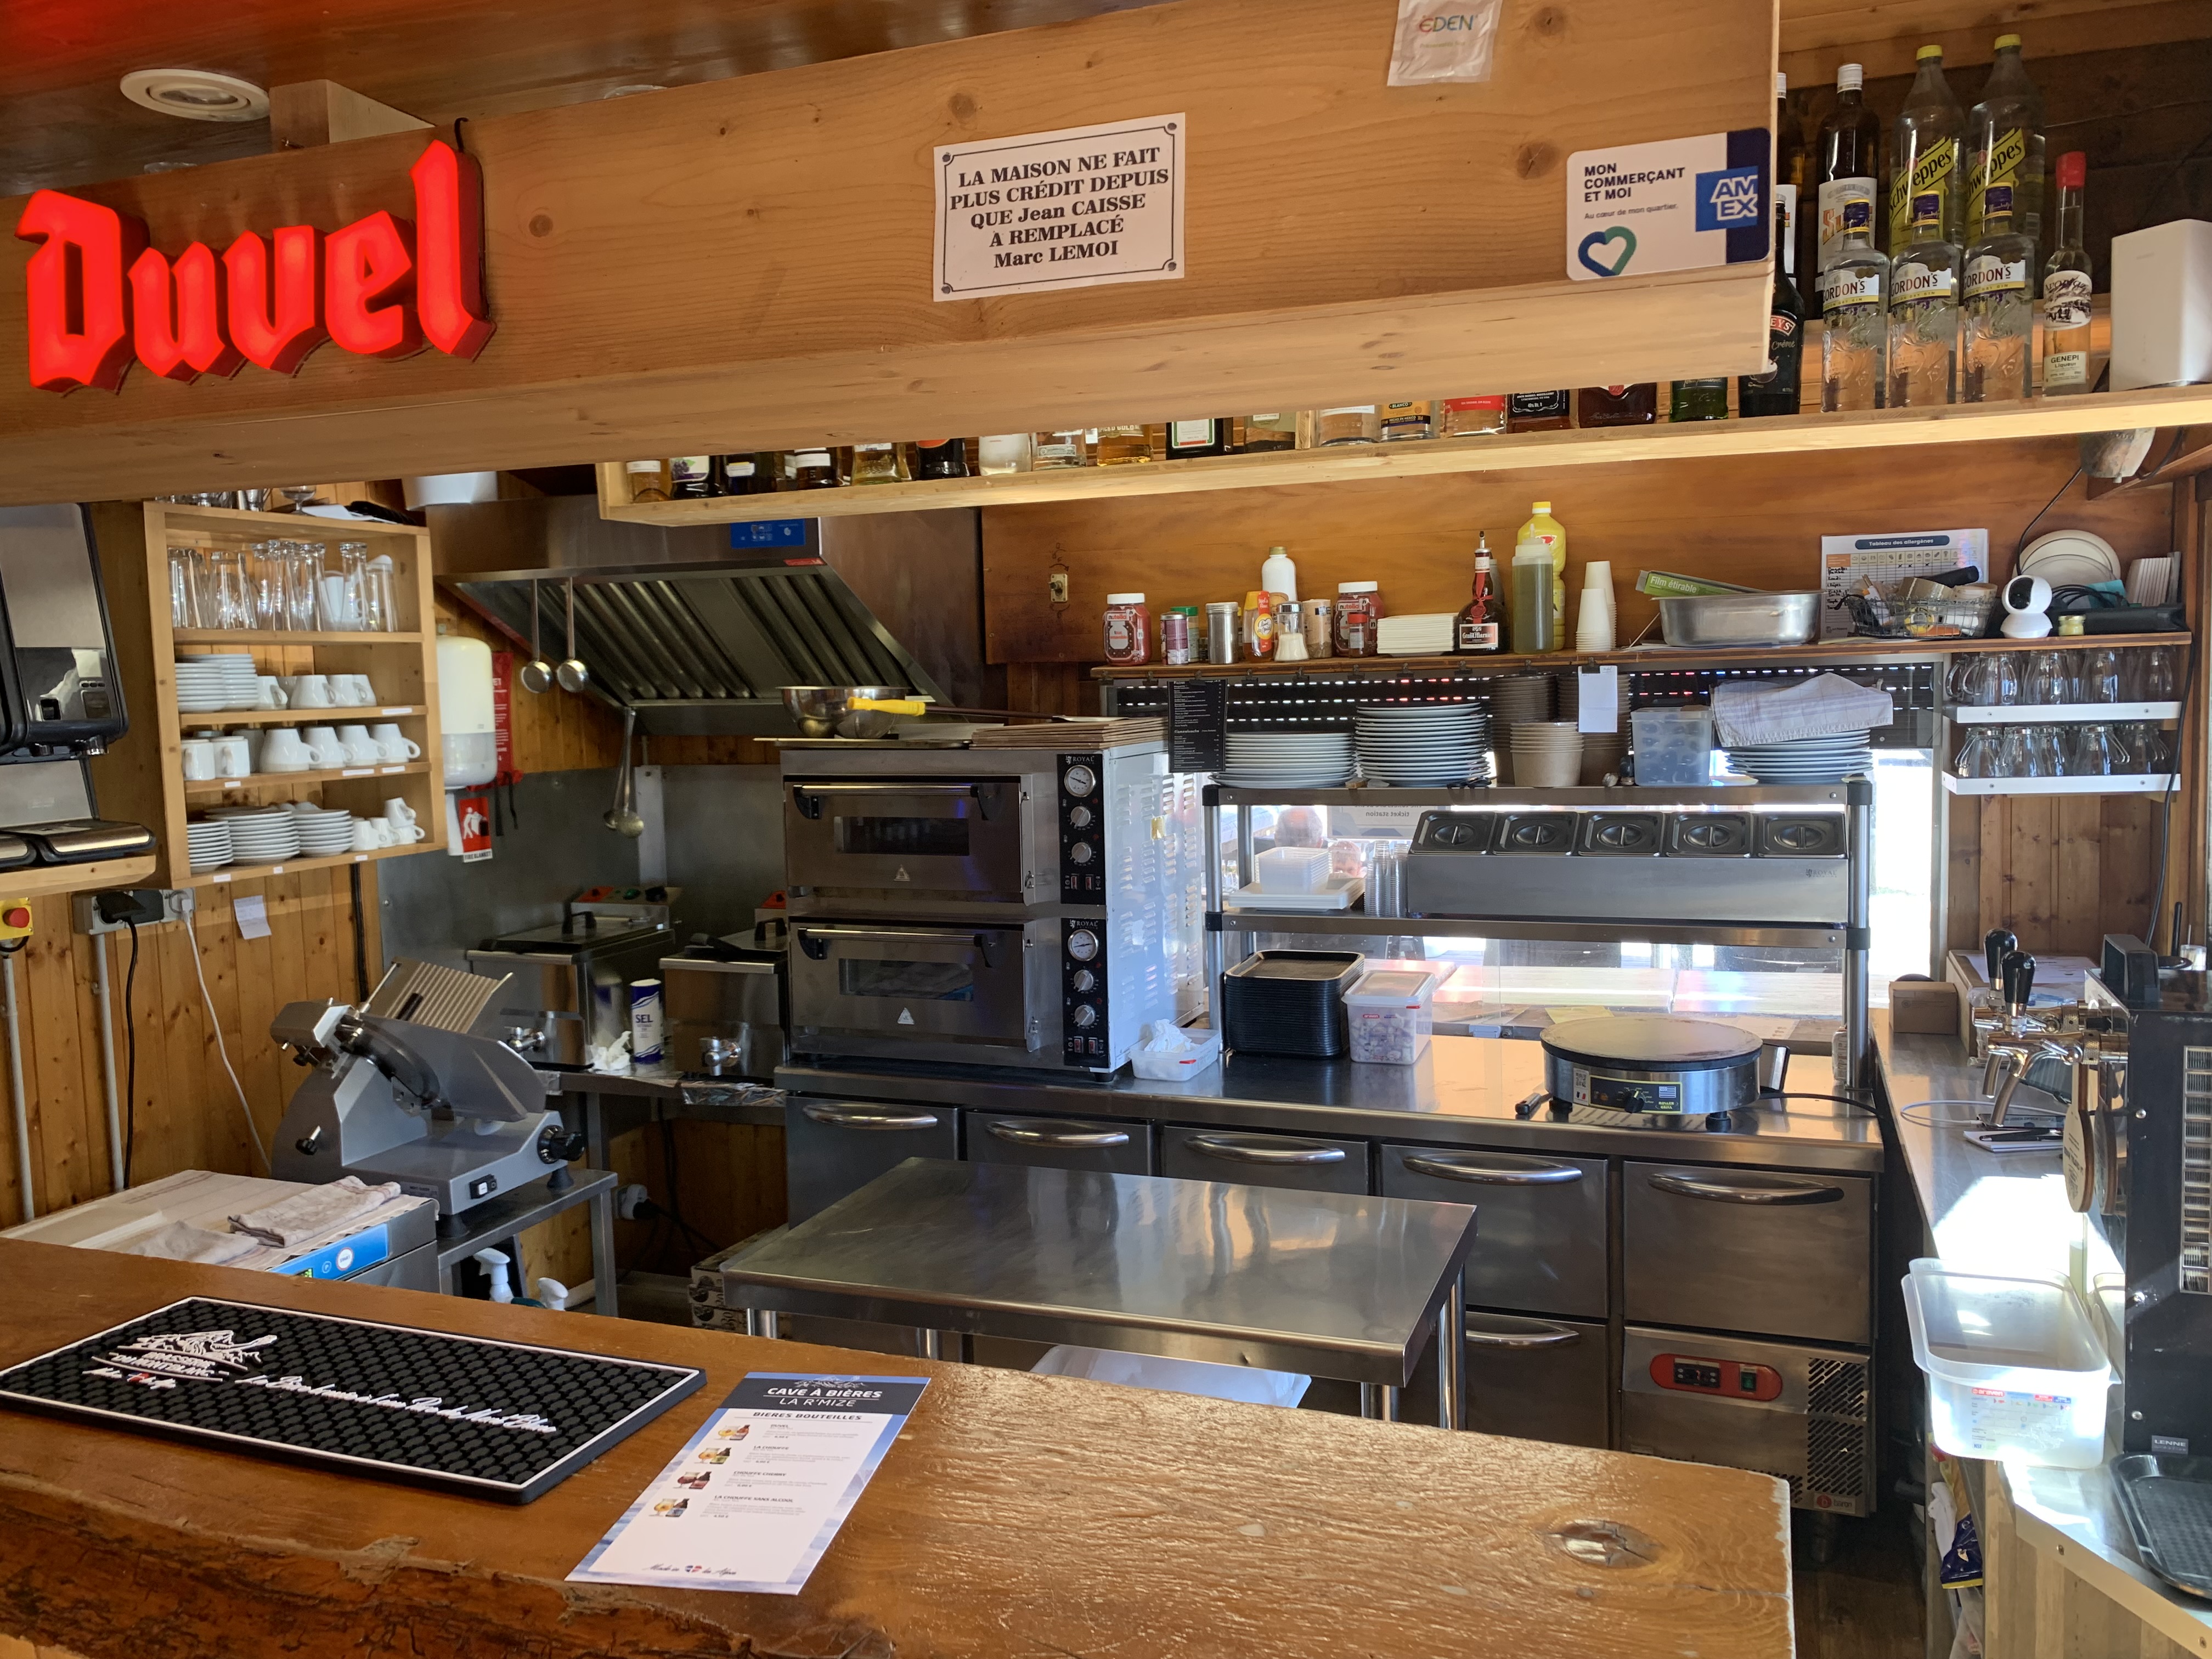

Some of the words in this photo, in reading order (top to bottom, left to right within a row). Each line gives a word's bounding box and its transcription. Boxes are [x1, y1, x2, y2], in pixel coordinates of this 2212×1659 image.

[1419, 15, 1474, 32] EDEN
[959, 171, 984, 188] LA
[990, 159, 1071, 183] MAISON
[1077, 154, 1107, 172] NE
[1113, 147, 1160, 167] FAIT
[1584, 163, 1617, 177] MON
[1584, 167, 1685, 189] COMMERÇANT
[950, 190, 1001, 210] PLUS
[1006, 179, 1085, 203] CRÉDIT
[1090, 168, 1169, 192] DEPUIS
[1584, 191, 1601, 202] ET
[1605, 187, 1632, 200] MOI
[970, 210, 1013, 229] QUE
[1018, 206, 1065, 223] Jean
[1071, 193, 1147, 216] CAISSE
[1595, 210, 1616, 218] cœur
[1009, 214, 1124, 245] REMPLACÉ
[994, 250, 1043, 268] Marc
[1049, 240, 1119, 262] LEMOI
[14, 139, 475, 388] Duvel
[2051, 355, 2079, 363] GENEPI
[1651, 576, 1667, 586] Film
[1668, 579, 1697, 593] étirable
[635, 1014, 653, 1023] SEL
[111, 1355, 137, 1364] DU
[768, 1387, 808, 1396] CAVE
[810, 1388, 821, 1396] À
[826, 1389, 882, 1398] BIÈRES
[803, 1398, 856, 1407] R'MIZE
